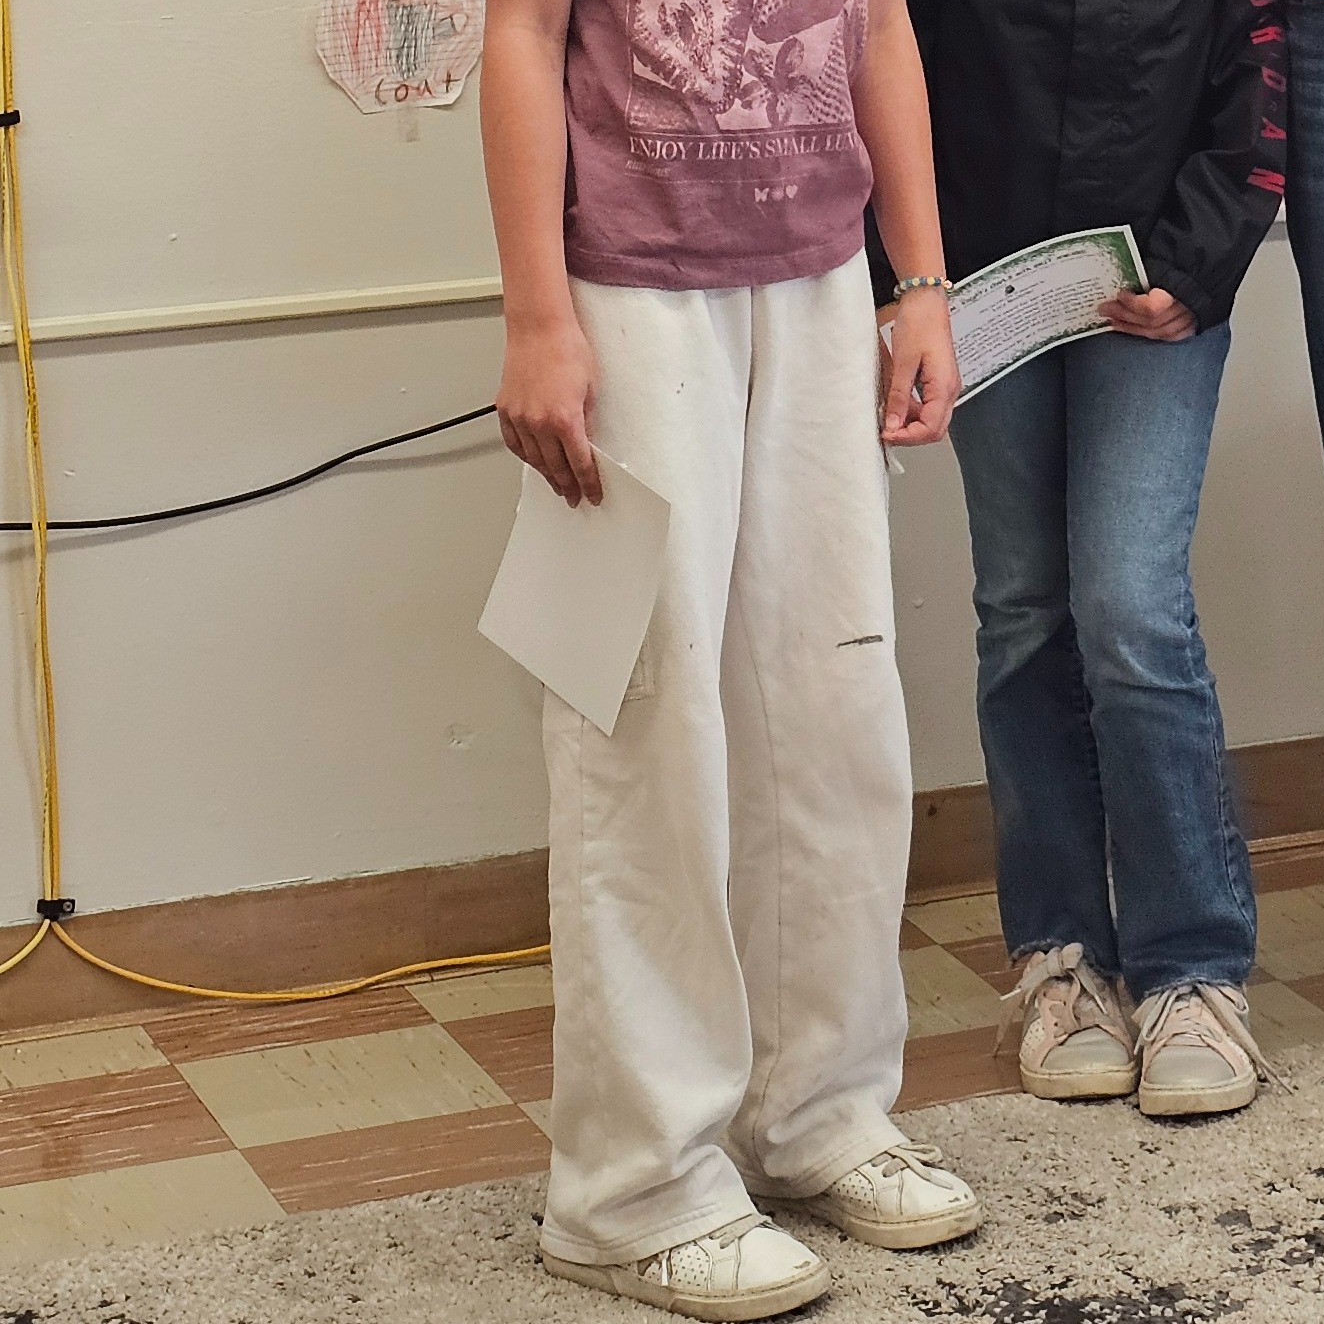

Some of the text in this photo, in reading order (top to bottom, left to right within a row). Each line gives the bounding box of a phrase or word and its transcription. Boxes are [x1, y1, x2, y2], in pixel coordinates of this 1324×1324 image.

[630, 136, 692, 160] ENJOY
[698, 141, 761, 160] LIFE'S
[765, 133, 821, 158] SMALL
